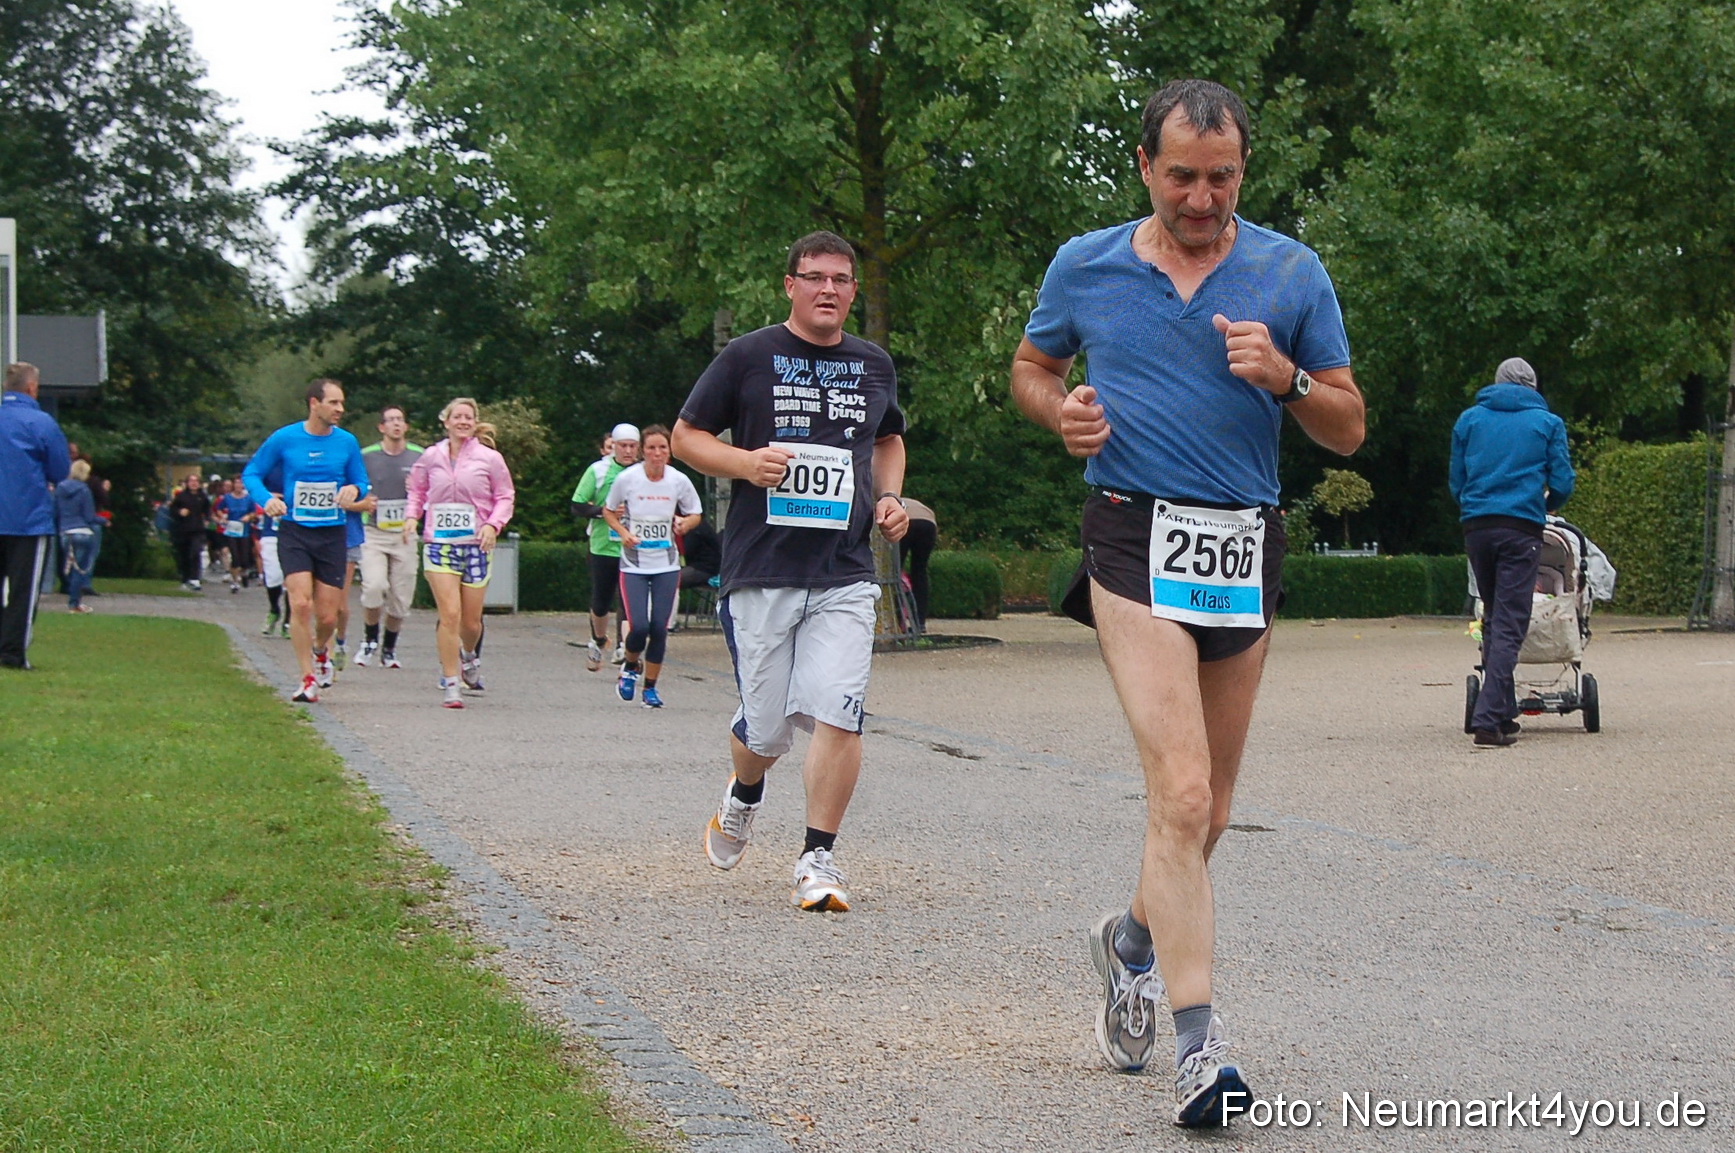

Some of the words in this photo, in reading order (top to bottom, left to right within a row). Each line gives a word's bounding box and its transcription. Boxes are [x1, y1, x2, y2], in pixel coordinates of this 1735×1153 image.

[793, 387, 820, 399] WAVES
[774, 399, 801, 411] BOARD
[801, 401, 821, 412] TIME
[799, 452, 839, 462] Neumarkt
[776, 464, 845, 497] 2097
[299, 492, 334, 506] 2629
[786, 502, 832, 516] Gerhard
[437, 513, 470, 528] 2628
[635, 524, 668, 539] 2690
[1163, 529, 1257, 580] 2566
[1190, 589, 1231, 609] Klaus
